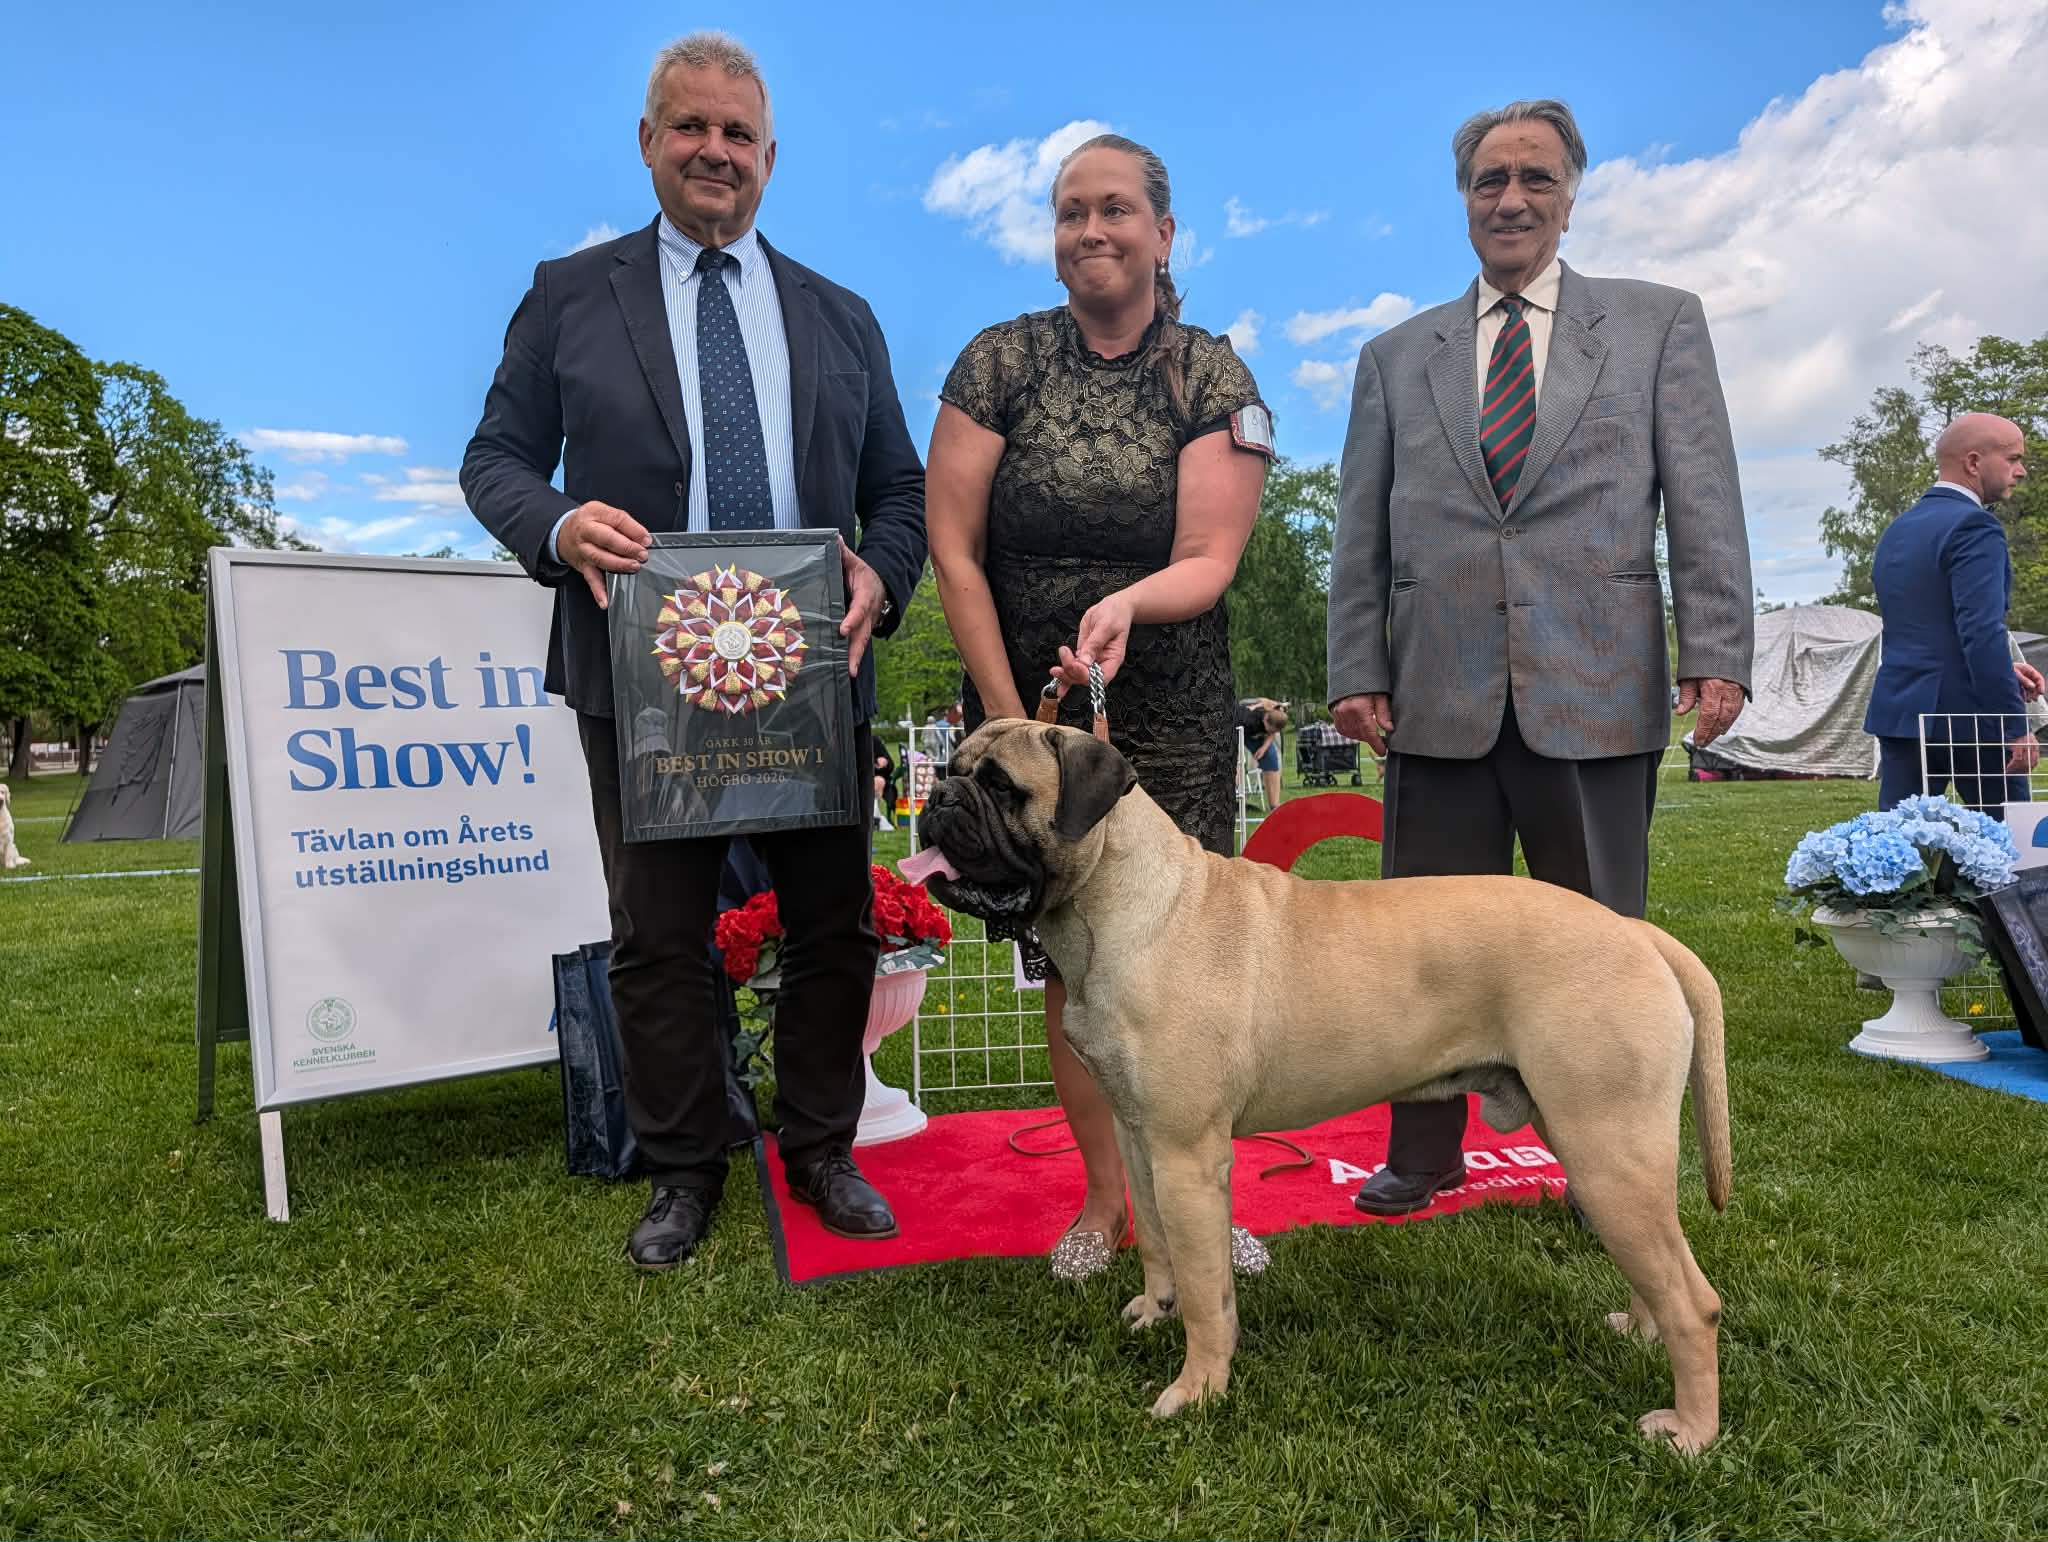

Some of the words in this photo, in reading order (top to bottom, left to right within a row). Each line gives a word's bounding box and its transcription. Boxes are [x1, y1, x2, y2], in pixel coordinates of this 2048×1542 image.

[278, 649, 458, 710] Best
[474, 651, 555, 708] in
[286, 723, 536, 792] Show!
[743, 737, 754, 747] 30
[656, 754, 711, 774] BEST
[716, 752, 741, 770] IN
[746, 749, 809, 768] SHOW
[291, 827, 394, 853] Tävlan
[404, 823, 449, 847] om
[458, 815, 534, 845] Årets
[295, 850, 550, 889] utställningshund
[293, 1049, 376, 1067] KENNELKLUBBEN
[311, 1042, 356, 1056] SVENSKA
